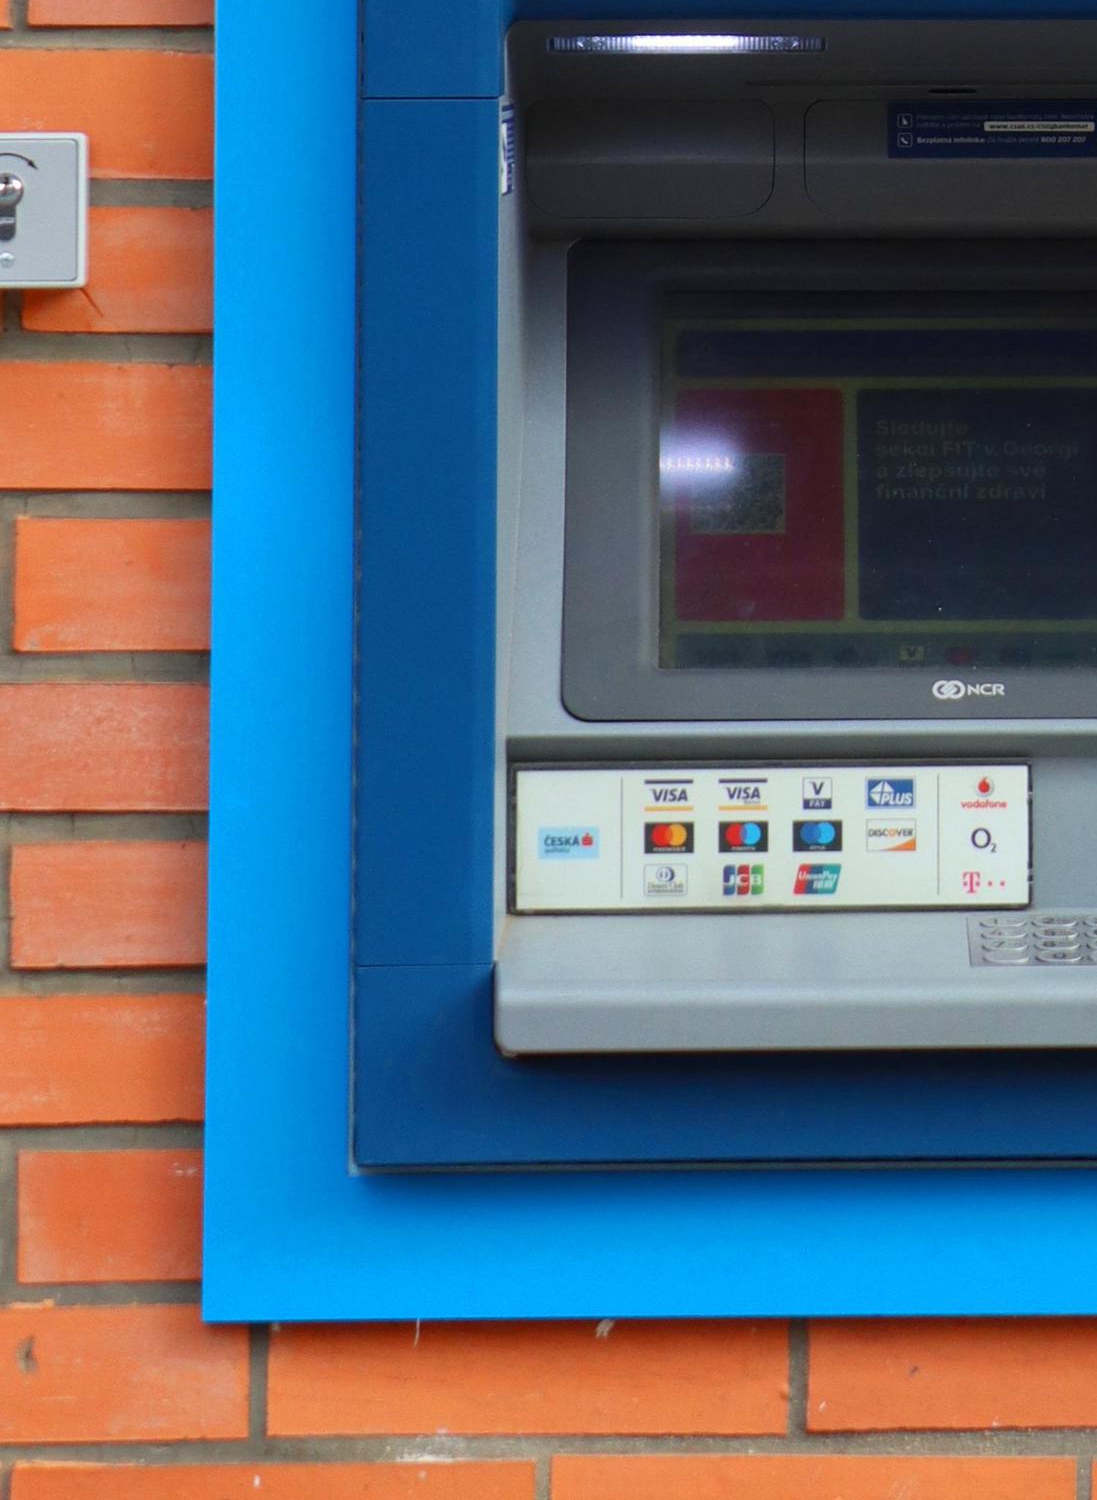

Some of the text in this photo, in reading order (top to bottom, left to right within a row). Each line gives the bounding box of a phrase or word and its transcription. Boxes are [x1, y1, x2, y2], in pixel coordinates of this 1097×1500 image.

[967, 684, 1005, 696] NCR
[726, 786, 761, 800] VISA
[811, 781, 824, 795] V
[651, 788, 688, 802] VISA
[881, 792, 912, 805] PLUS
[961, 800, 1007, 809] vodafone
[868, 828, 914, 837] DISCOVER
[544, 833, 579, 847] ČESKÁ
